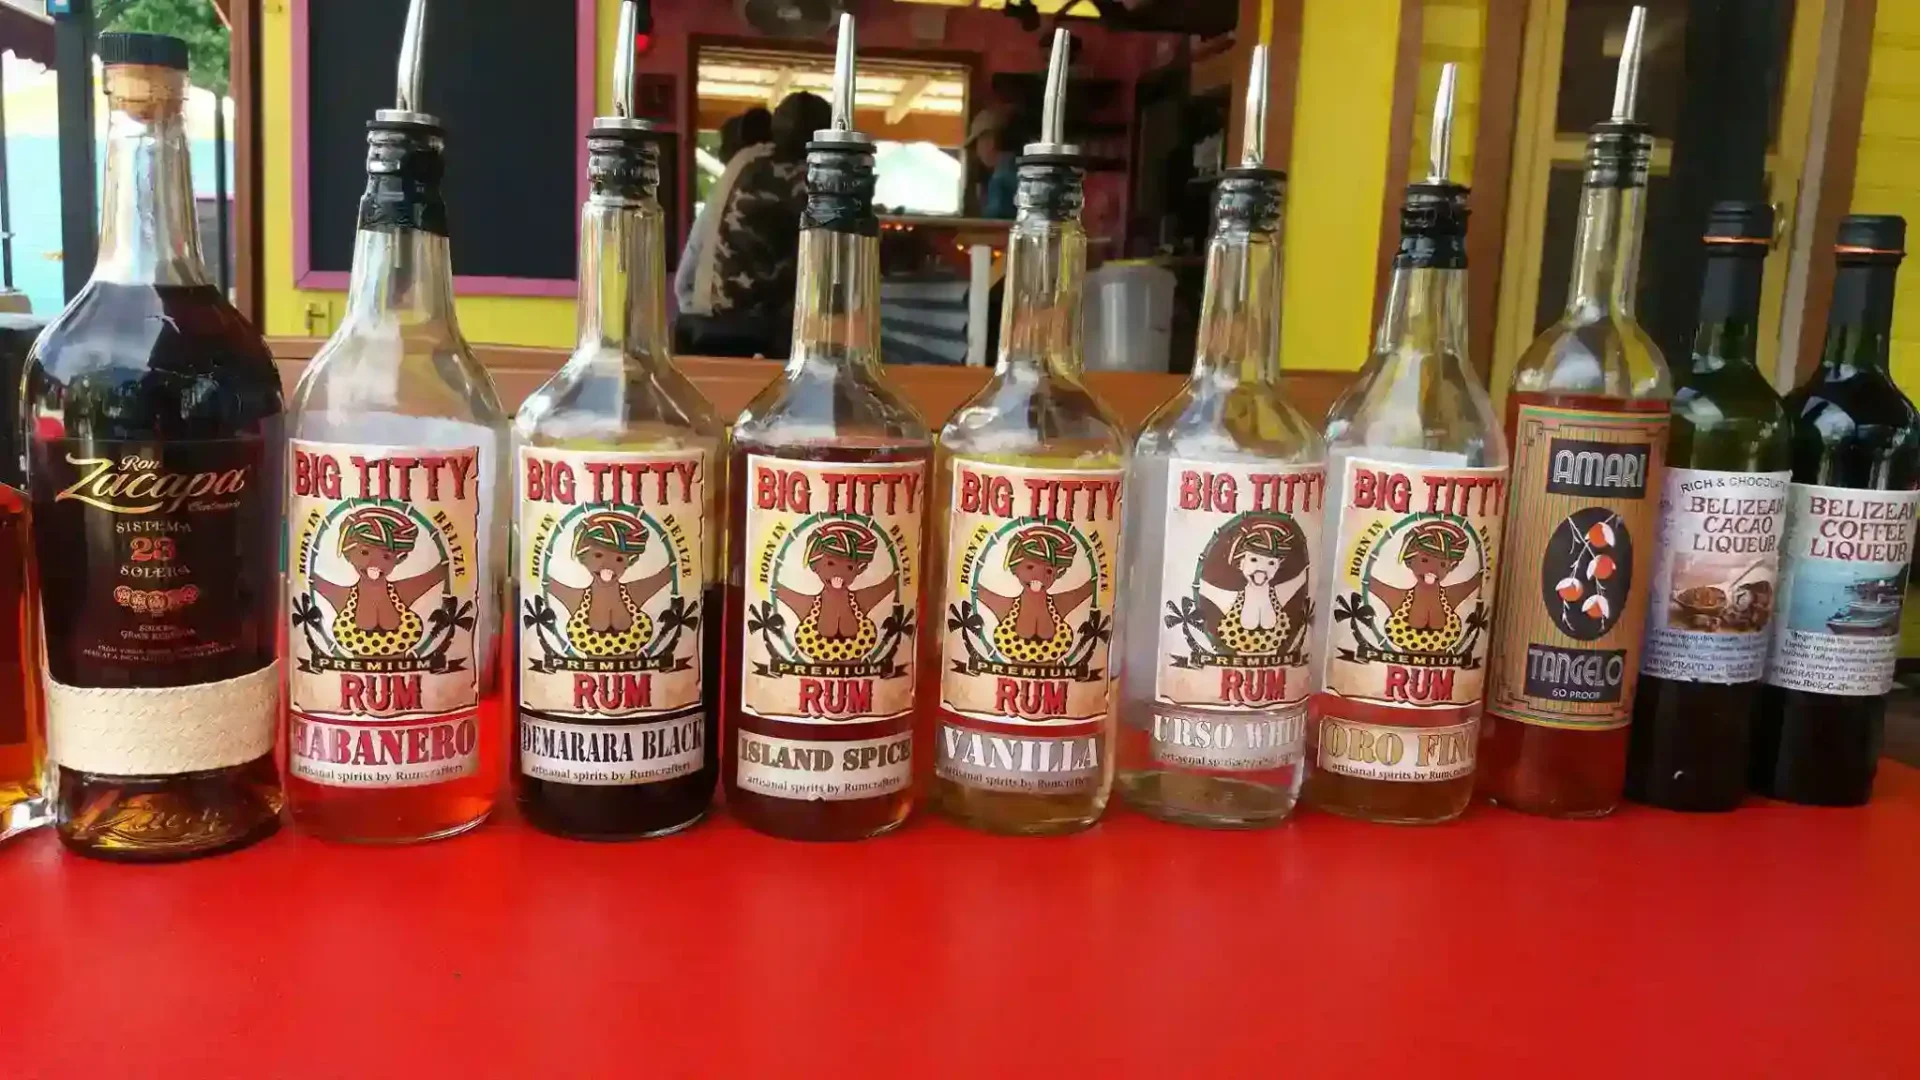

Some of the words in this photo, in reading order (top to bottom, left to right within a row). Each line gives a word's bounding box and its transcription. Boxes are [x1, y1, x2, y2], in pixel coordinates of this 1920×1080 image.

[117, 455, 160, 472] Ron
[292, 450, 344, 501] BIG
[350, 456, 475, 502] TITTY
[1552, 449, 1646, 488] AMARI
[55, 452, 245, 514] Zacapa
[526, 456, 577, 506] BIG
[584, 460, 699, 506] TITTY
[757, 466, 812, 515] BIG
[821, 472, 920, 516] TITTY
[960, 468, 1014, 520] BIG
[1024, 478, 1120, 523] TITTY
[1179, 470, 1238, 514] BIG
[1354, 468, 1412, 514] BIG
[1680, 479, 1713, 493] RICH
[1716, 477, 1725, 487] &
[1690, 496, 1785, 515] BELIZEAN
[1810, 495, 1918, 520] BELIZEAN
[116, 519, 192, 535] SISTEMA
[1703, 516, 1773, 534] CACAO
[1819, 518, 1906, 541] COFFEE
[130, 536, 177, 561] 23
[298, 531, 313, 574] BORN
[308, 509, 321, 529] IN
[433, 510, 466, 577] BELIZE
[532, 534, 546, 577] BORN
[541, 513, 555, 535] IN
[663, 513, 692, 578] BELIZE
[760, 540, 777, 583] BORN
[774, 521, 787, 539] IN
[961, 545, 978, 584] BORN
[975, 525, 989, 542] IN
[1350, 537, 1371, 577] BORN
[1368, 519, 1384, 537] IN
[1693, 534, 1776, 554] LIQUEUR
[1810, 538, 1907, 562] LIQUEUR
[120, 564, 191, 578] SOLERA
[318, 658, 433, 671] PREMIUM
[552, 658, 661, 671] PREMIUM
[778, 662, 882, 676] PREMIUM
[977, 661, 1078, 677] PREMIUM
[1200, 654, 1294, 667] PREMIUM
[1366, 649, 1462, 666] PREMIUM
[1528, 649, 1624, 687] TANGELO
[339, 672, 425, 714] RUM
[572, 672, 653, 711] RUM
[799, 677, 874, 715] RUM
[994, 677, 1069, 715] RUM
[1220, 668, 1287, 702] RUM
[1385, 665, 1455, 702] RUM
[1552, 688, 1568, 698] 60
[1570, 689, 1601, 700] PROOF
[291, 719, 476, 766] HABANERO
[521, 722, 633, 763] DEMARARA
[642, 719, 703, 760] BLACK
[740, 738, 834, 772] ISLAND
[842, 739, 911, 772] SPICE
[943, 725, 1098, 773] VANILLA
[1323, 722, 1404, 766] ORO
[337, 770, 373, 783] spirits
[376, 770, 393, 783] by
[573, 769, 609, 783] spirits
[612, 769, 626, 783] by
[747, 775, 787, 791] artisanal
[790, 781, 824, 795] spirits
[827, 781, 841, 795] by
[985, 775, 1018, 790] spirits
[1020, 777, 1034, 791] by
[1332, 762, 1376, 778] artisanal
[1378, 769, 1411, 782] spirits
[1414, 770, 1428, 781] by
